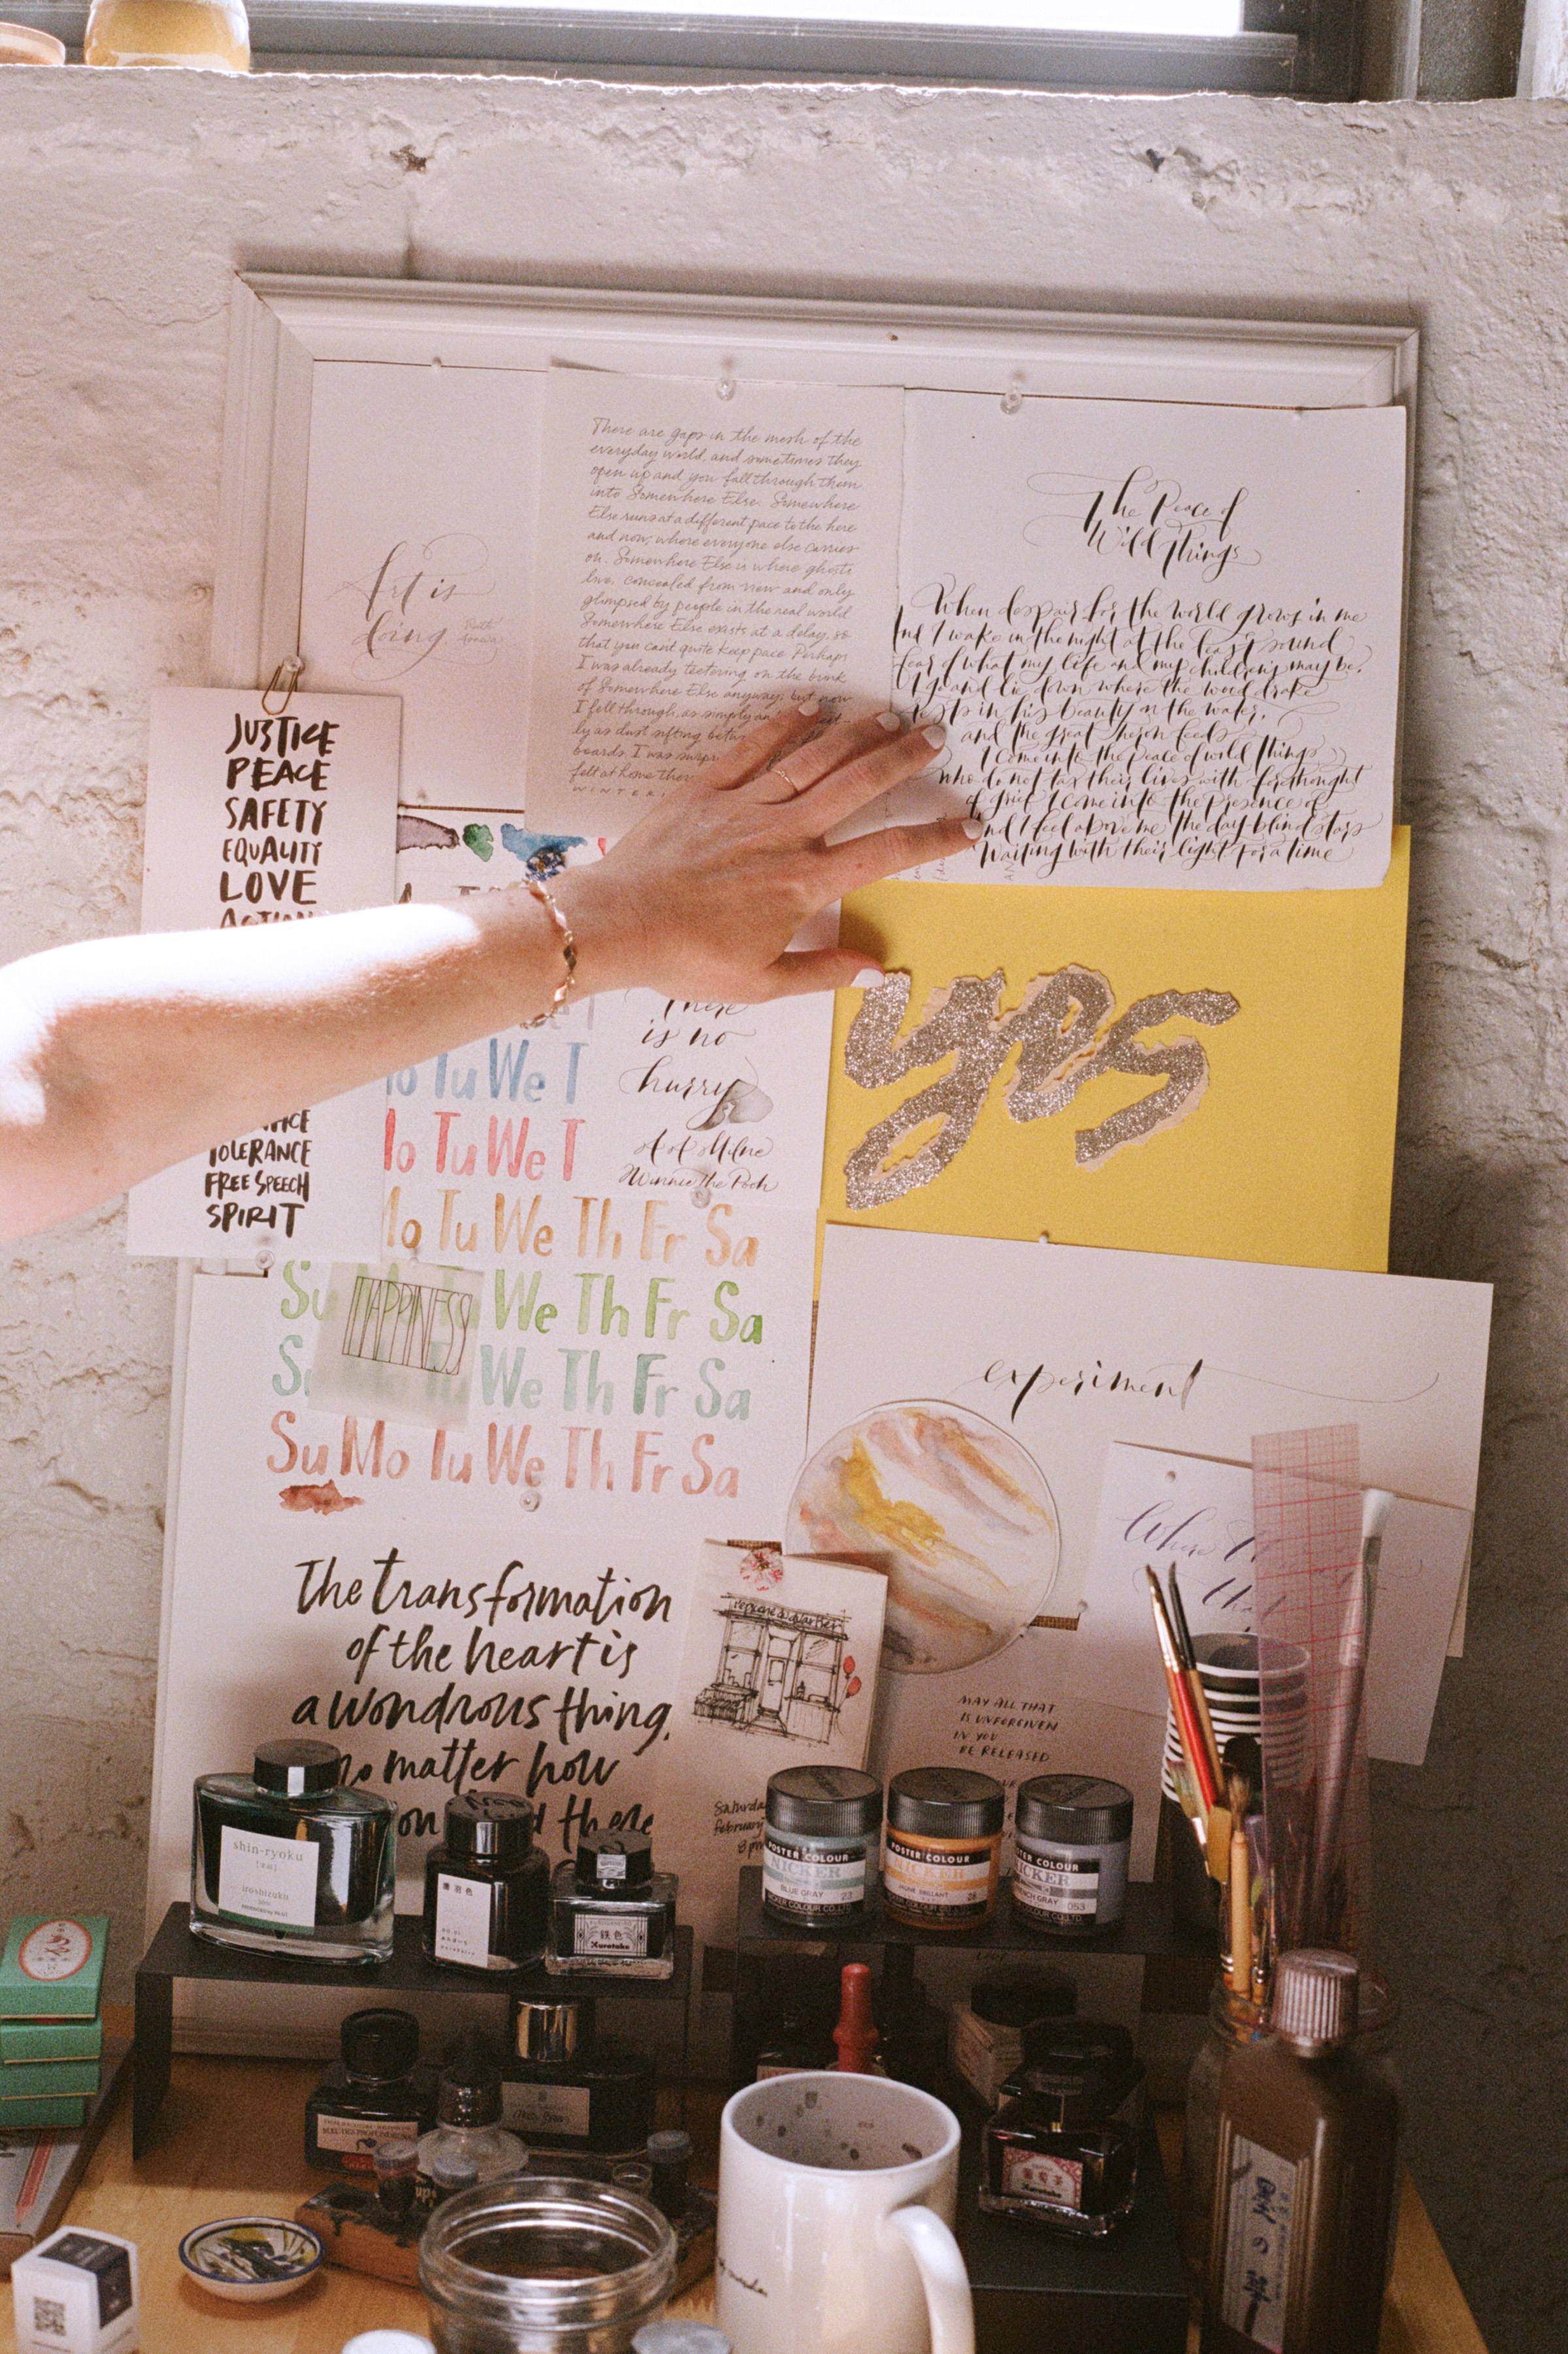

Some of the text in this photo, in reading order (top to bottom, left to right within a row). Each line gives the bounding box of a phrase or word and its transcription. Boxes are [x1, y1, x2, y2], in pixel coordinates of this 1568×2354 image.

[593, 417, 862, 451] There are gaps in the mesh of the
[590, 443, 659, 469] everyday
[710, 449, 745, 463] and
[742, 452, 823, 466] sometimes
[827, 452, 862, 474] they
[590, 466, 863, 493] open up and you fall through them
[1126, 588, 1162, 631] the
[1166, 599, 1232, 623] world
[1309, 597, 1327, 623] in
[1334, 608, 1369, 623] me
[225, 712, 340, 759] JUSTICE
[1095, 742, 1124, 768] the
[1184, 742, 1207, 776] of
[1204, 739, 1253, 764] wild
[227, 757, 331, 792] PEACE
[225, 796, 328, 837] SAFETY
[223, 835, 323, 867] EQUALITY
[220, 869, 318, 905] LOVE
[642, 1019, 756, 1048] is no
[489, 1038, 546, 1103] We
[843, 963, 1240, 1212] yes
[434, 1111, 478, 1176] Tu
[487, 1115, 546, 1182] We
[204, 1170, 310, 1202] FREE SPEECH
[206, 1202, 306, 1238] SPIRIT
[437, 1189, 760, 1268] Tu We Th Fr Sa
[495, 1269, 558, 1334] We
[573, 1272, 630, 1338] Th
[644, 1277, 691, 1341] Fr
[709, 1280, 763, 1345] Sa
[480, 1344, 545, 1409] We
[557, 1348, 615, 1416] Th
[633, 1353, 679, 1417] Fr
[694, 1357, 752, 1421] Sa
[980, 1359, 1205, 1423] experiment
[267, 1410, 330, 1476] Su
[339, 1415, 411, 1480] Mo
[487, 1422, 546, 1487] We
[561, 1425, 615, 1492] Th
[630, 1429, 674, 1494] Fr
[681, 1433, 740, 1499] Sa
[295, 1547, 674, 1627] The transformation
[346, 1623, 639, 1684] of the heart is
[291, 1693, 318, 1727] a
[327, 1682, 551, 1733] wondrous
[958, 1695, 1057, 1714] MAY ALL THAT
[953, 1731, 998, 1742] IN YOU
[960, 1712, 1058, 1732] IS UNFORGIVEN
[382, 1737, 520, 1797] matter
[527, 1740, 621, 1798] how
[959, 1745, 1051, 1763] BE RELEASED
[714, 1799, 765, 1817] Saturda
[233, 1840, 304, 1862] shin-ryoku
[768, 1841, 849, 1863] POSTER COLOUR
[772, 1855, 842, 1879] NICKER
[891, 1842, 970, 1864] POSTER COLOUR
[1037, 1857, 1079, 1872] COLOUR
[894, 1857, 964, 1879] NICKER
[1018, 1862, 1070, 1887] ICKER
[242, 1885, 289, 1900] iroshizuku
[780, 1884, 824, 1898] BLUE GRAY
[1037, 1895, 1058, 1905] GRAY
